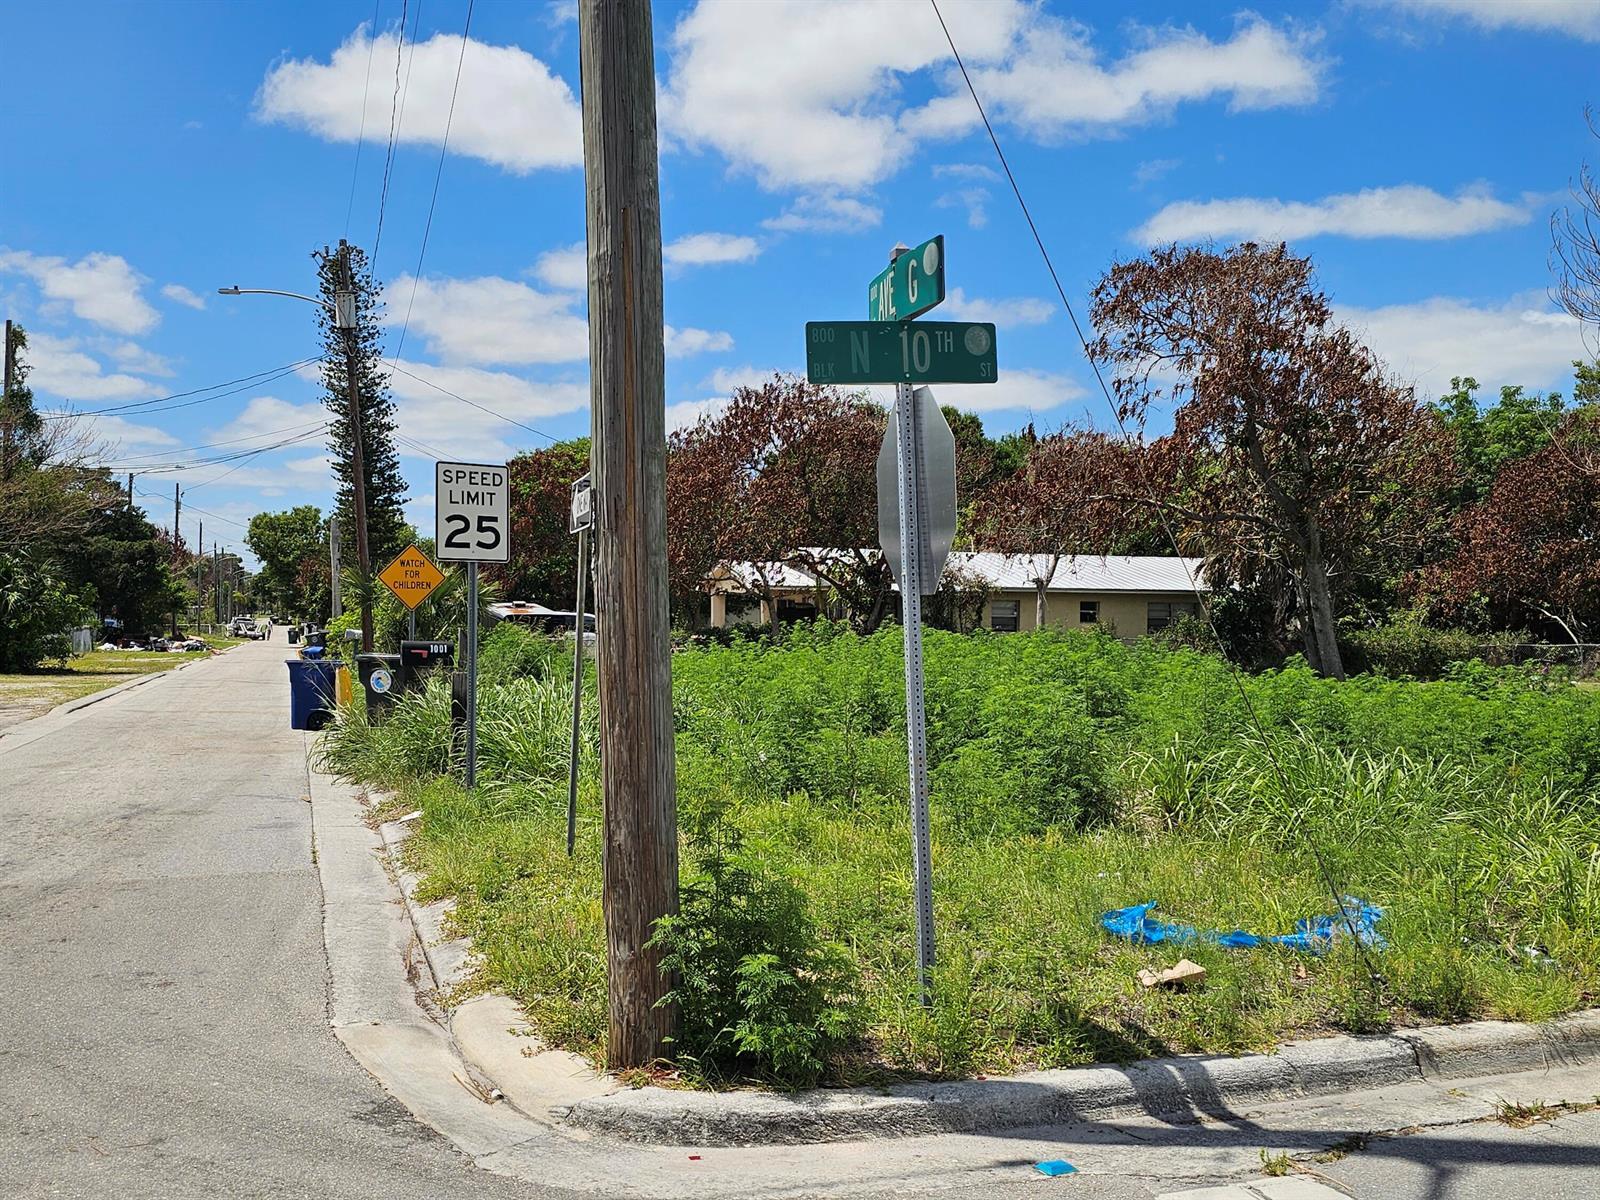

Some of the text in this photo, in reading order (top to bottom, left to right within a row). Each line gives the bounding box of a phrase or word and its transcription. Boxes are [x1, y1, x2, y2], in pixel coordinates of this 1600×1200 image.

[879, 259, 918, 321] AVE G
[812, 328, 835, 343] 800
[850, 330, 870, 373] N
[980, 362, 992, 377] ST
[813, 363, 836, 378] BLK
[442, 469, 503, 487] SPEED
[449, 490, 496, 506] LIMIT
[444, 514, 501, 550] 25
[400, 559, 425, 568] WATCH
[404, 570, 420, 578] FOR
[393, 580, 431, 589] CHILDREN
[430, 644, 447, 653] 1001
